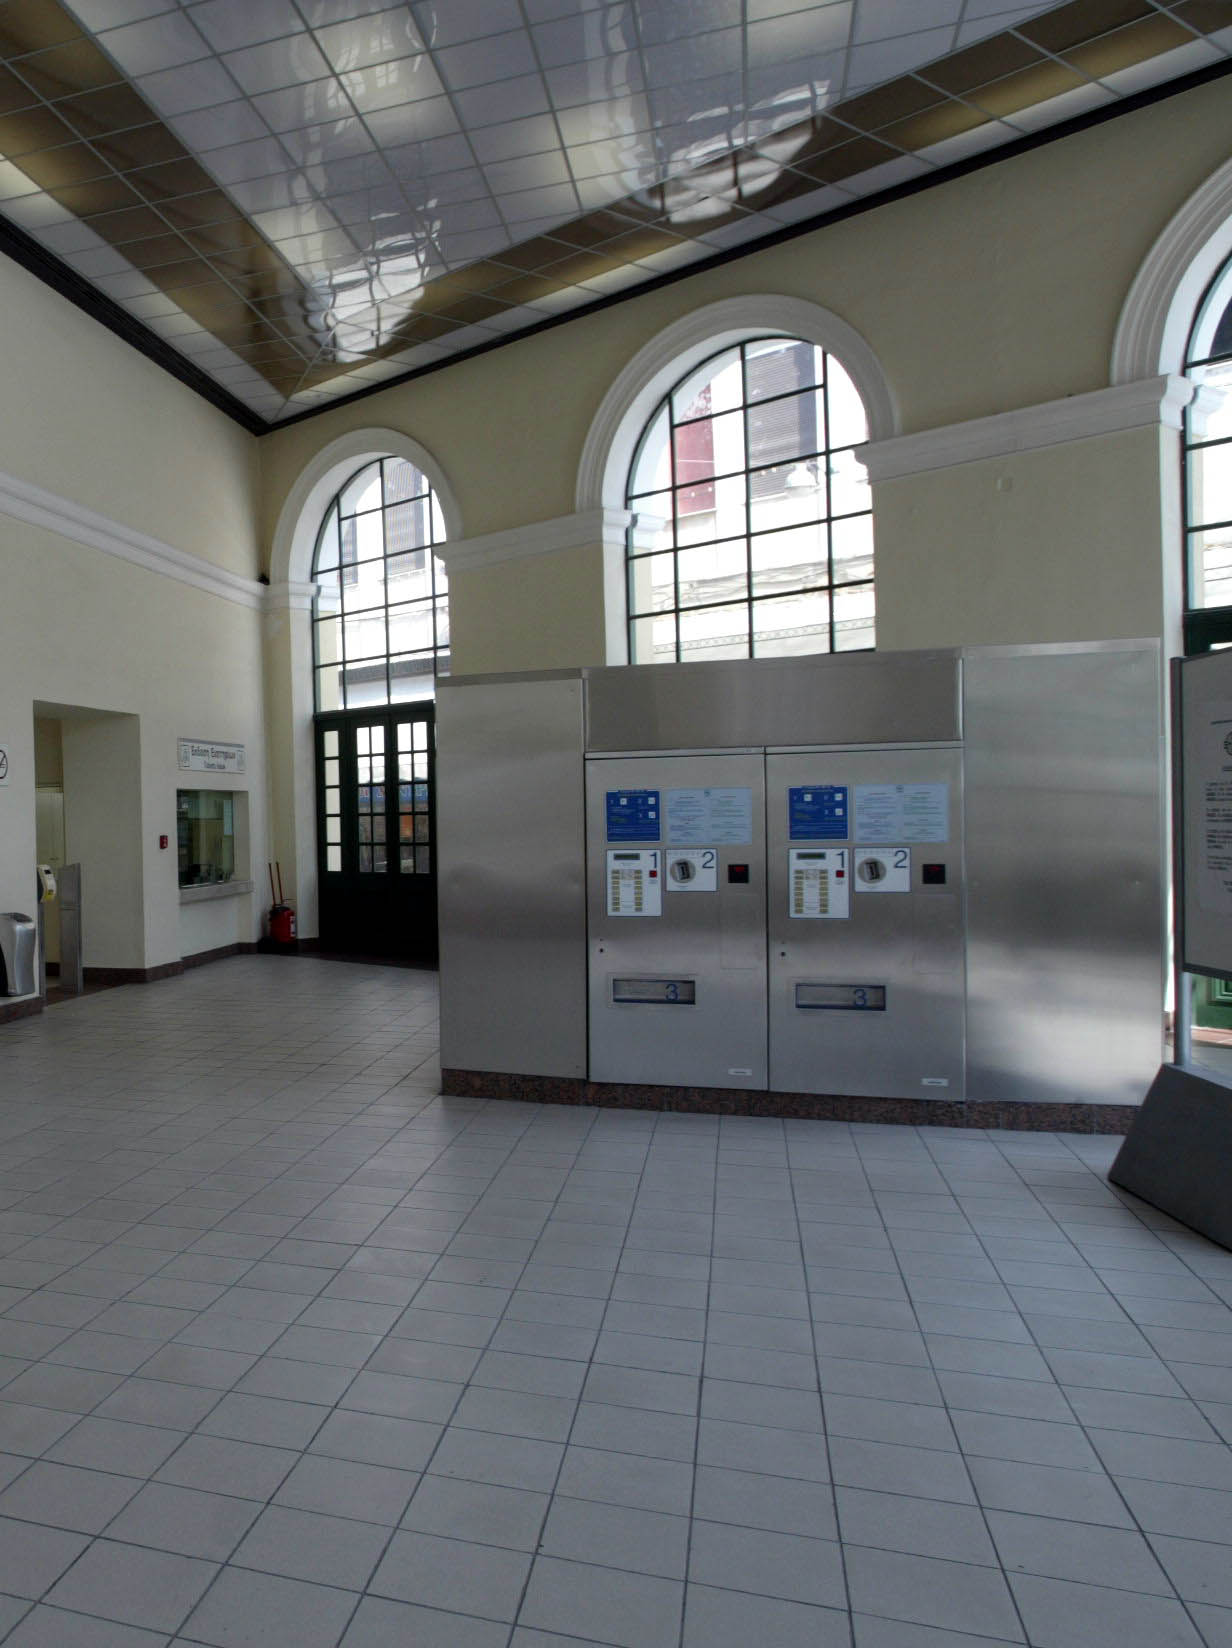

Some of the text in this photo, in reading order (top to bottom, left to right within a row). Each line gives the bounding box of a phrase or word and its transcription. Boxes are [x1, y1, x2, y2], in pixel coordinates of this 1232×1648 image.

[649, 852, 657, 869] 1
[702, 851, 715, 869] 2
[836, 851, 845, 868] 1
[894, 850, 908, 869] 2
[665, 983, 679, 1001] 3
[853, 988, 867, 1006] 3
